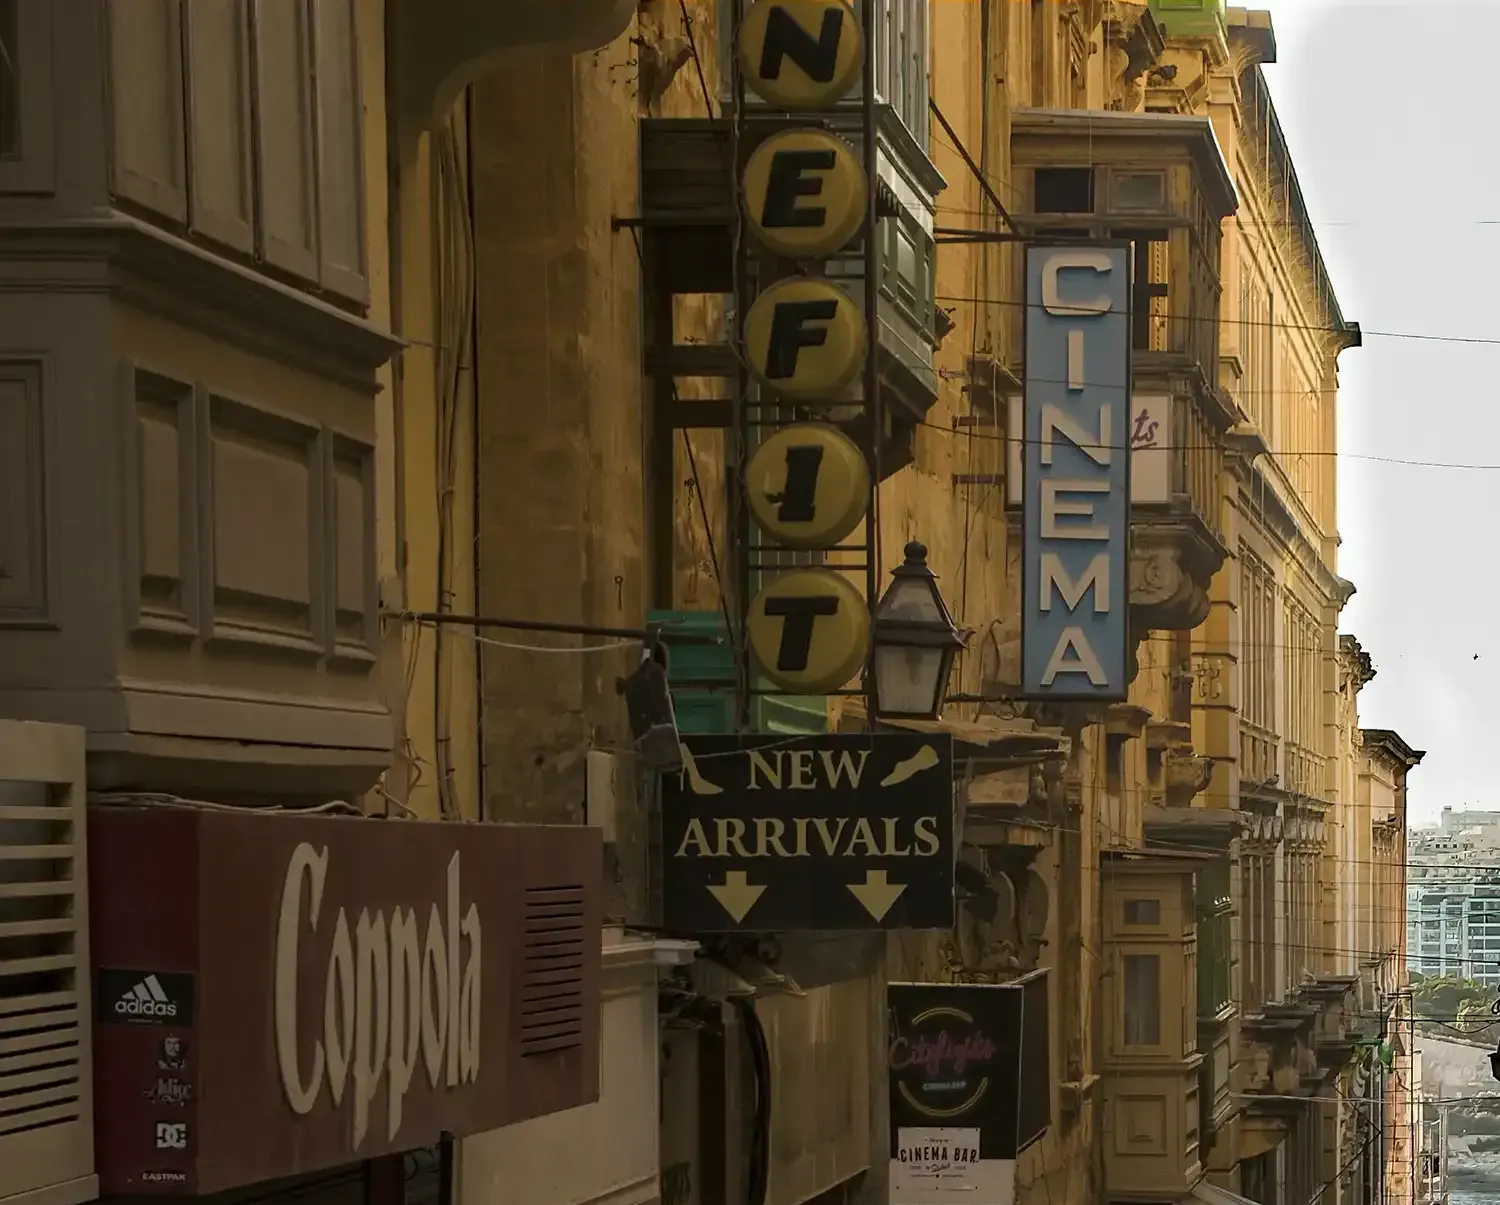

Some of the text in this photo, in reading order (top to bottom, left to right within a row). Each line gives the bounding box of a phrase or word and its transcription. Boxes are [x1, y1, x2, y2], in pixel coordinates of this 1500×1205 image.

[1040, 252, 1113, 688] CINEMA
[746, 750, 872, 791] NEW
[674, 816, 941, 858] ARRIVALS
[114, 998, 178, 1017] adidas
[274, 842, 482, 1153] Coppola
[900, 1146, 948, 1163] CINEMA
[142, 1171, 188, 1182] EASTPAK
